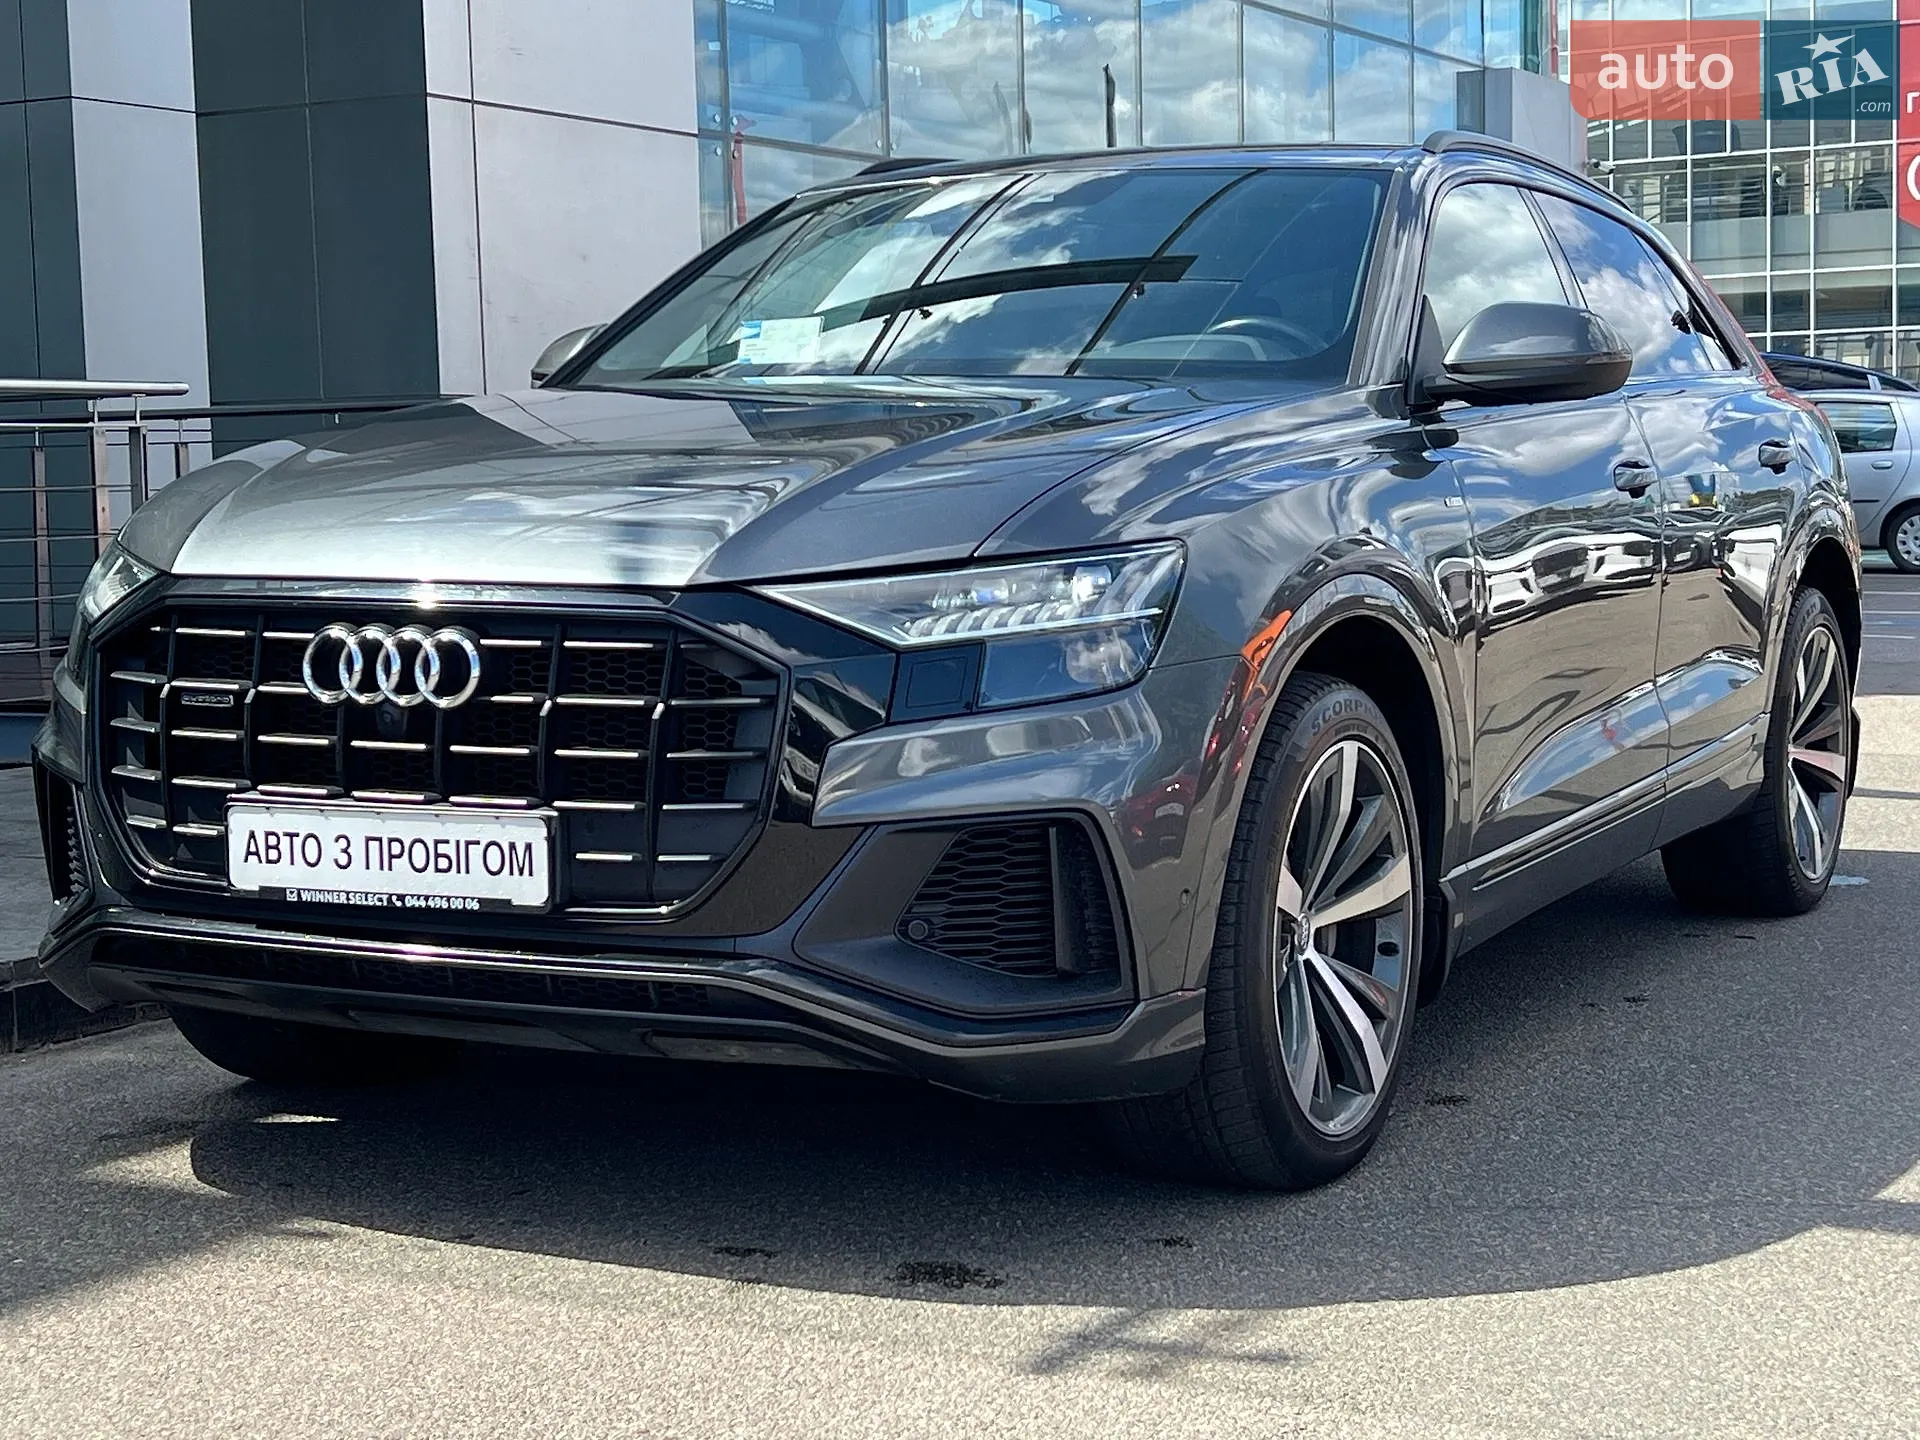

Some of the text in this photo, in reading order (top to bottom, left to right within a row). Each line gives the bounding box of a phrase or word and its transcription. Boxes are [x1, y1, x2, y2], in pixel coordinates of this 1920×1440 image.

[243, 829, 322, 868] АВТО
[364, 835, 534, 877] ПРОБІГОМ
[300, 889, 349, 904] WINNER
[349, 892, 389, 907] SELECT
[405, 895, 426, 908] 044
[450, 897, 463, 910] 00
[465, 898, 480, 911] 06
